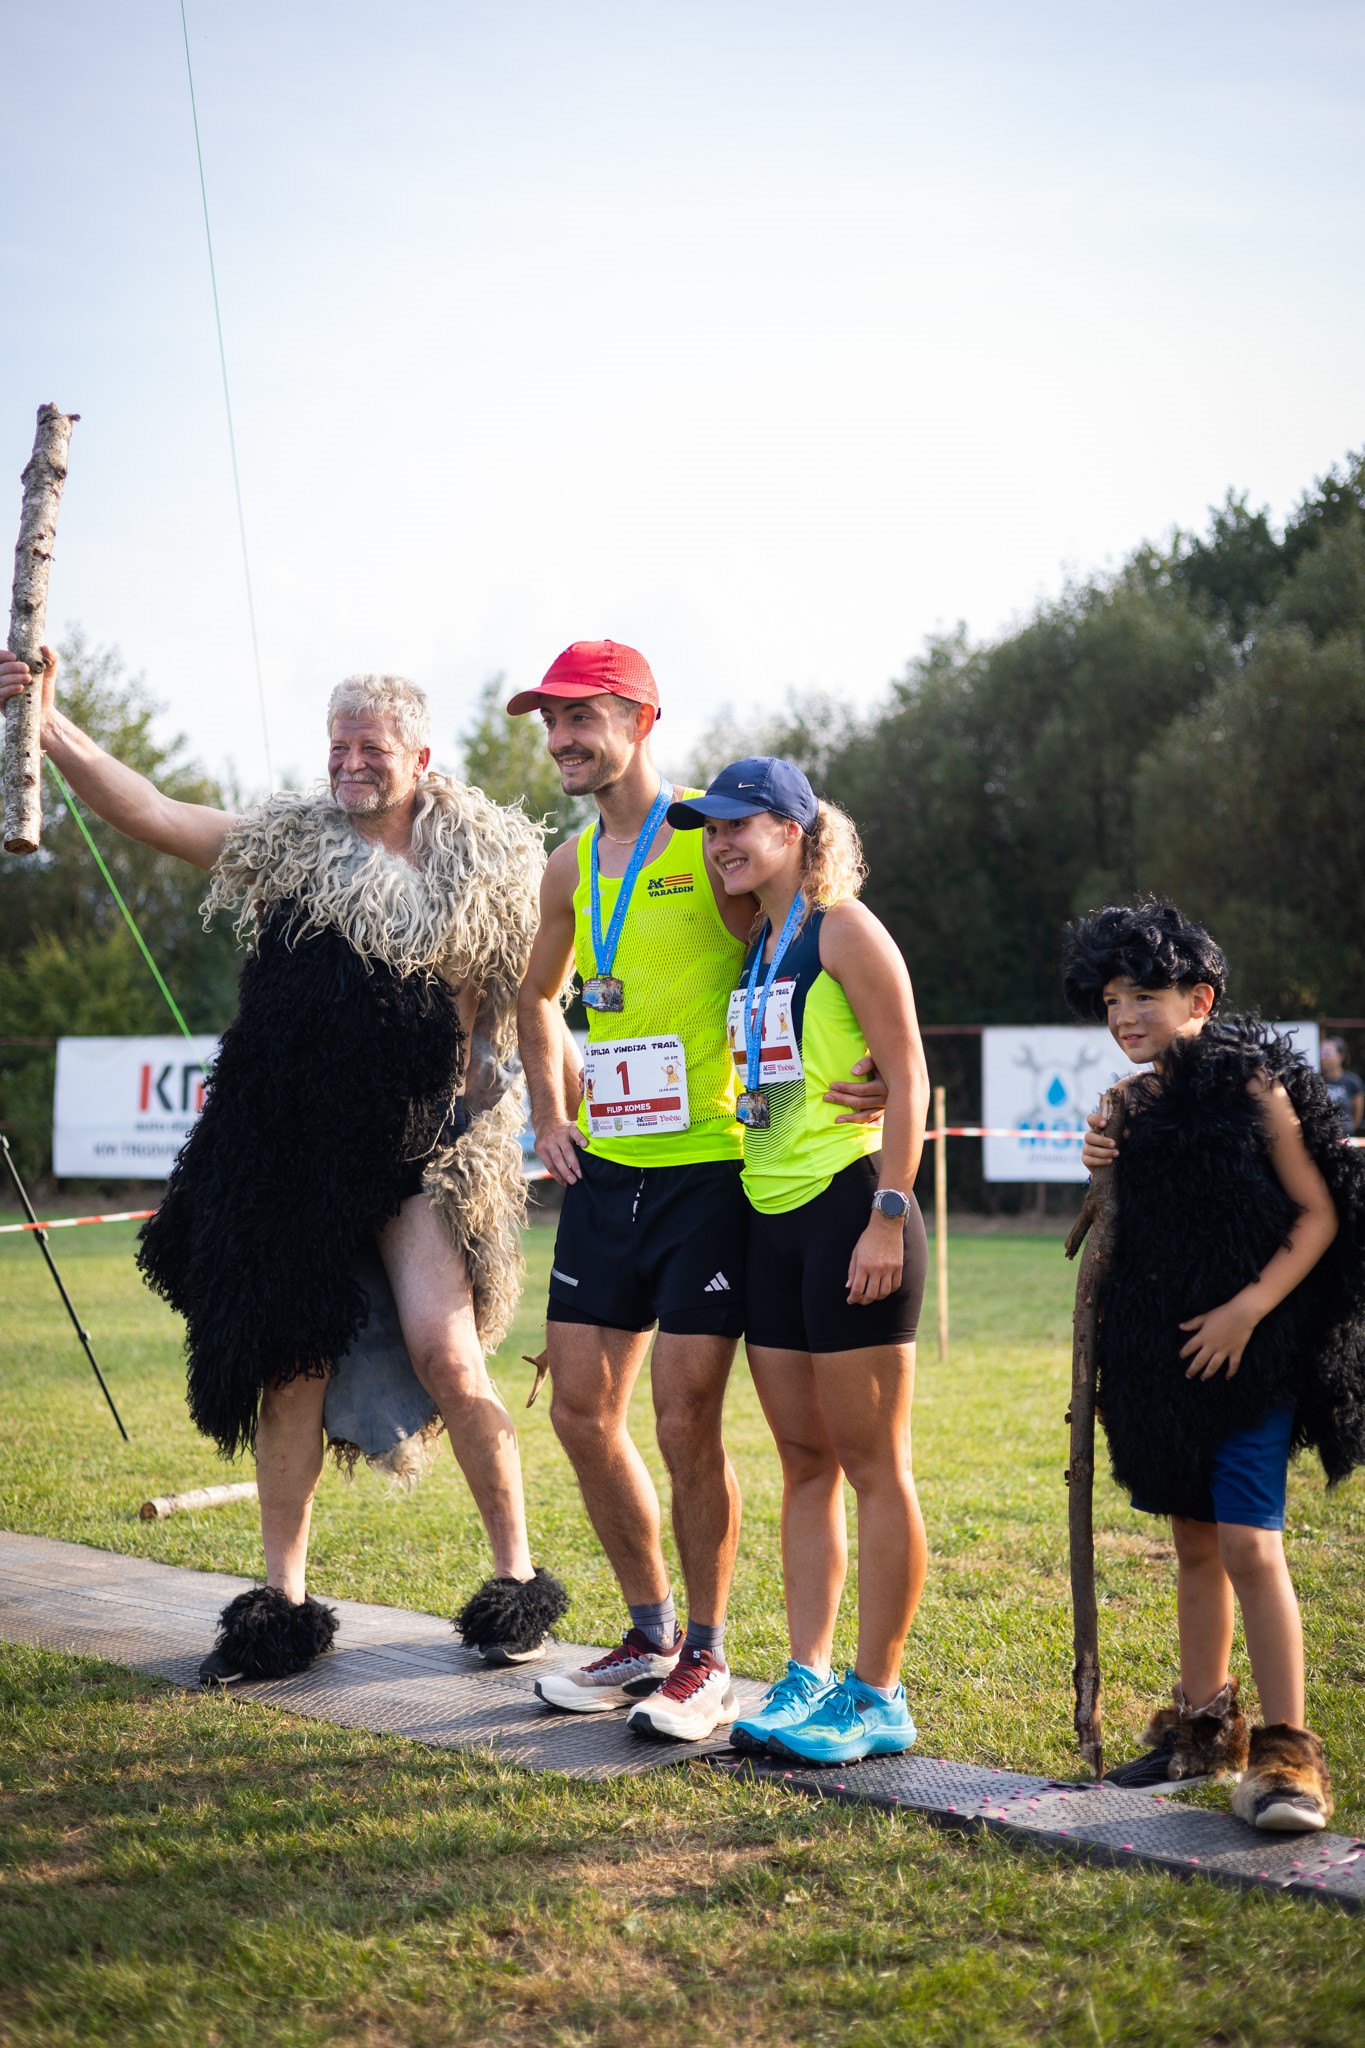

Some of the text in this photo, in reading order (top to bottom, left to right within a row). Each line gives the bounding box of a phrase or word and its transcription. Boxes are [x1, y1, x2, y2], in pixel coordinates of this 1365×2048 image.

[648, 886, 694, 897] VARAŽDIN
[613, 1044, 647, 1054] VINDIJA
[651, 1041, 678, 1050] TRAIL
[616, 1061, 630, 1095] 1
[624, 1103, 651, 1112] KOMES
